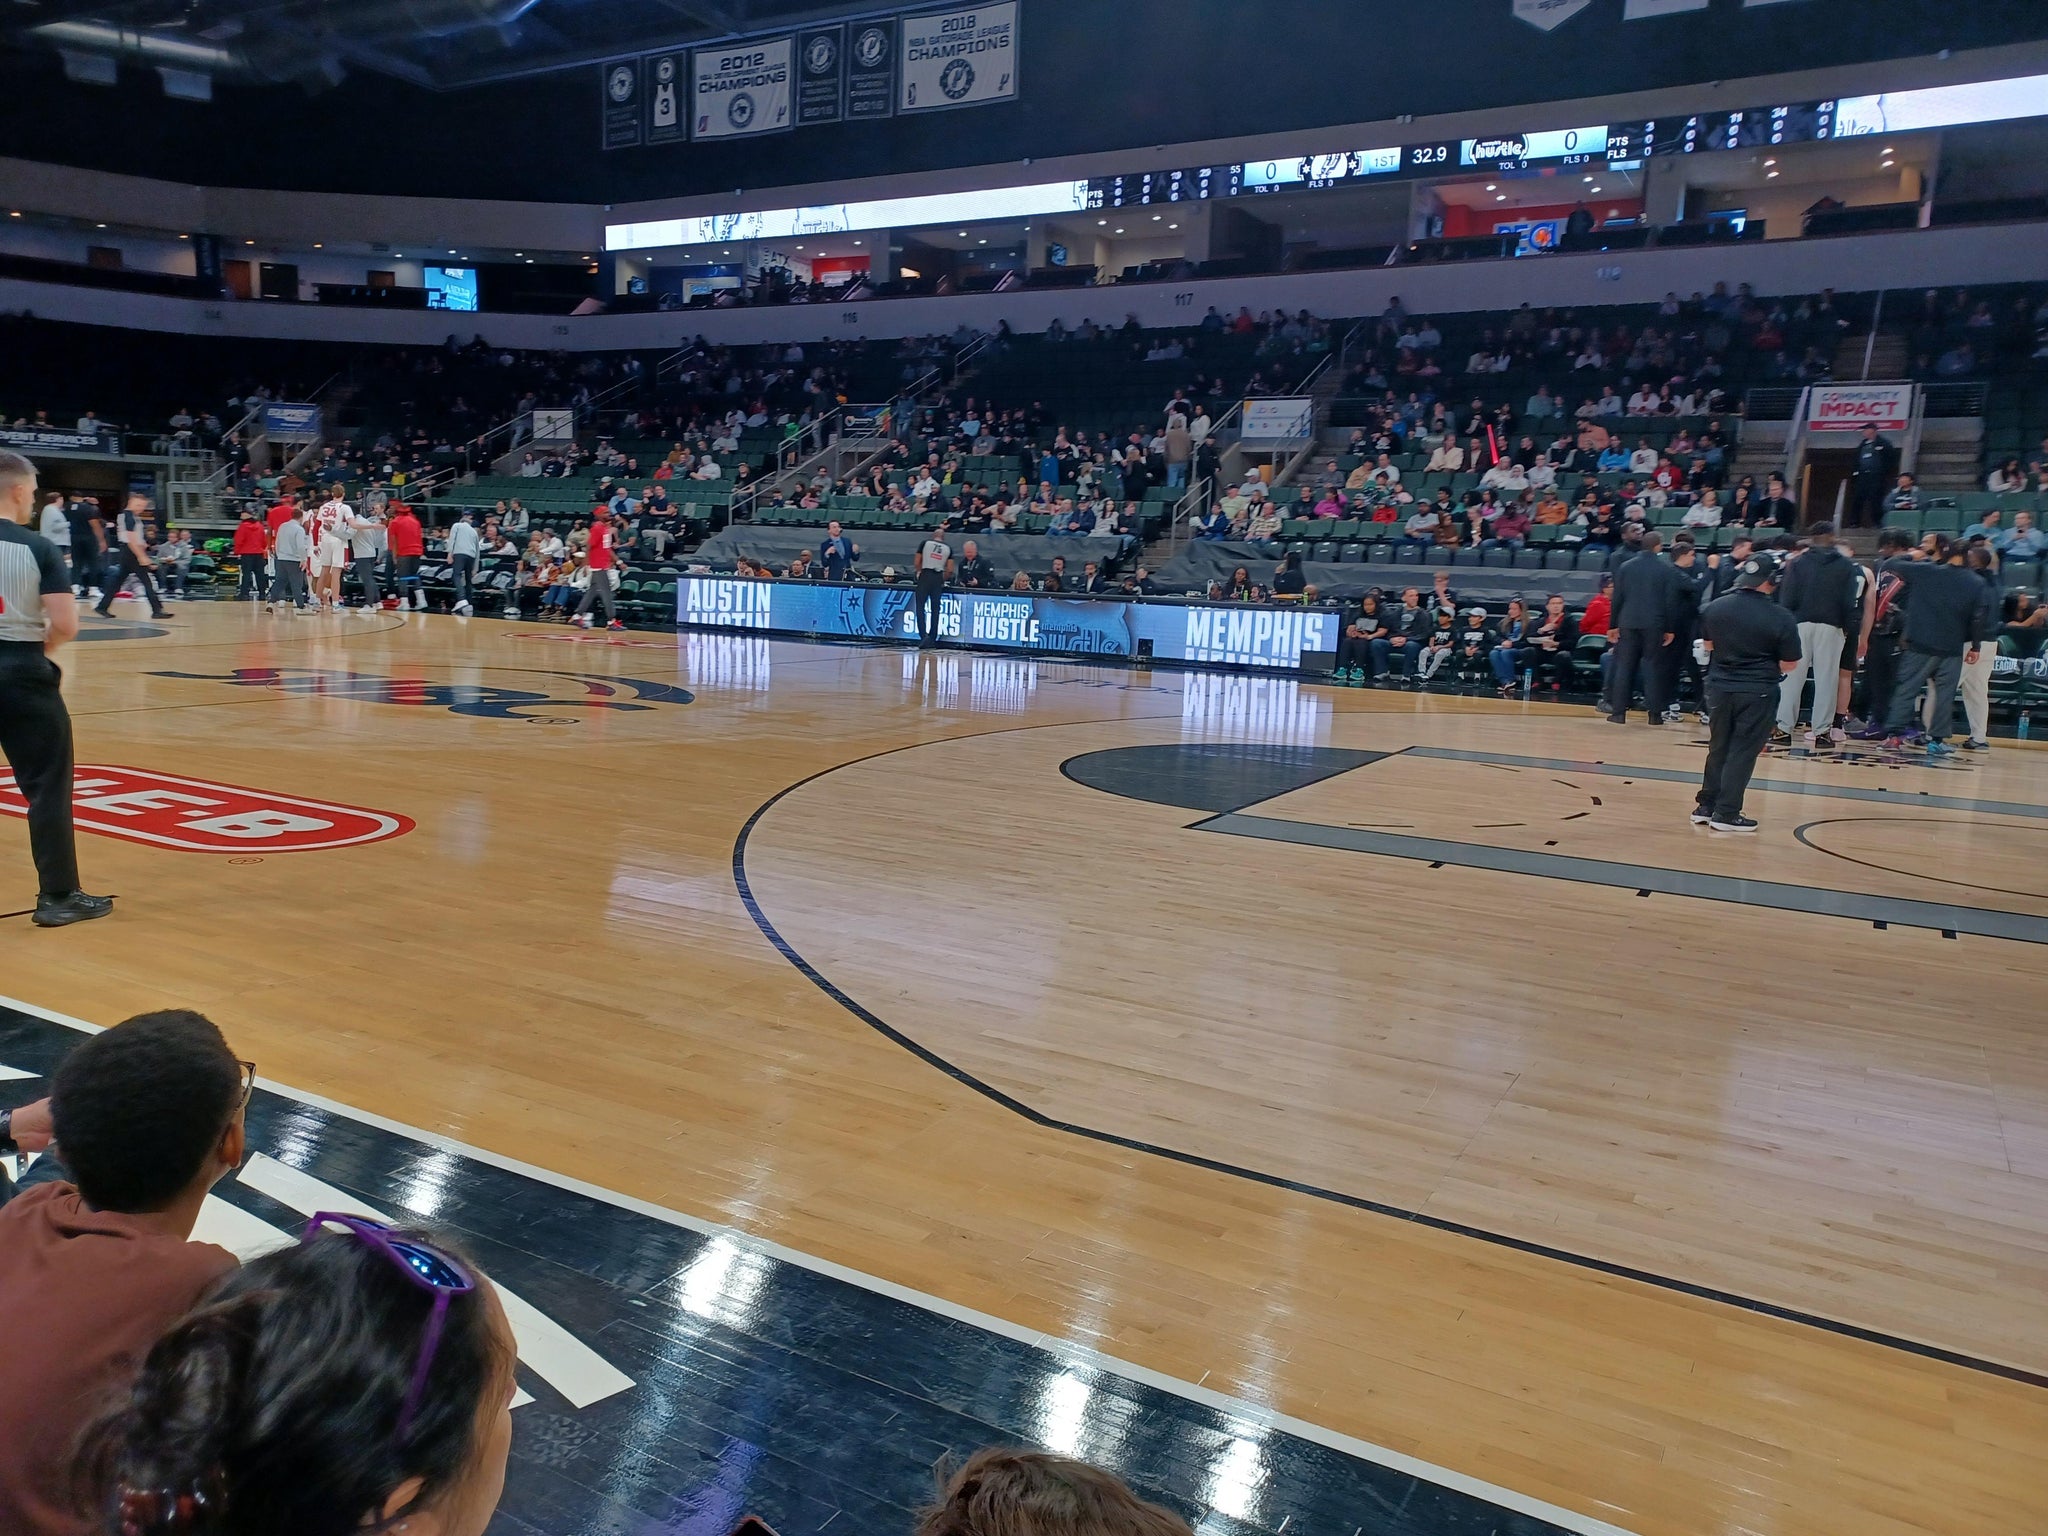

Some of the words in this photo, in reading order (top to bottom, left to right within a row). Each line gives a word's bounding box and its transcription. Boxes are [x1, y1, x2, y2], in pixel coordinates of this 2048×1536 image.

[942, 15, 976, 33] 2018
[908, 35, 1010, 61] CHAMPIONS
[720, 53, 765, 71] 2012
[699, 70, 787, 94] CHAMPIONS
[660, 98, 670, 115] 3
[1565, 131, 1578, 151] 0
[1607, 136, 1629, 148] PTS
[1374, 156, 1396, 168] 1ST
[1412, 147, 1447, 164] 32.9
[1563, 156, 1581, 164] FLS
[1606, 149, 1627, 159] FLS
[1266, 162, 1277, 180] 0
[1499, 162, 1516, 170] TOL
[1308, 181, 1324, 189] FLS
[1088, 190, 1104, 199] PTS
[1088, 199, 1103, 209] FLS
[1819, 401, 1899, 417] IMPACT
[322, 506, 337, 518] 34
[687, 578, 771, 612] AUSTIN
[973, 601, 1029, 619] MEMPHIS
[972, 616, 1040, 643] HUSTLE
[1186, 611, 1324, 658] MEMPHIS
